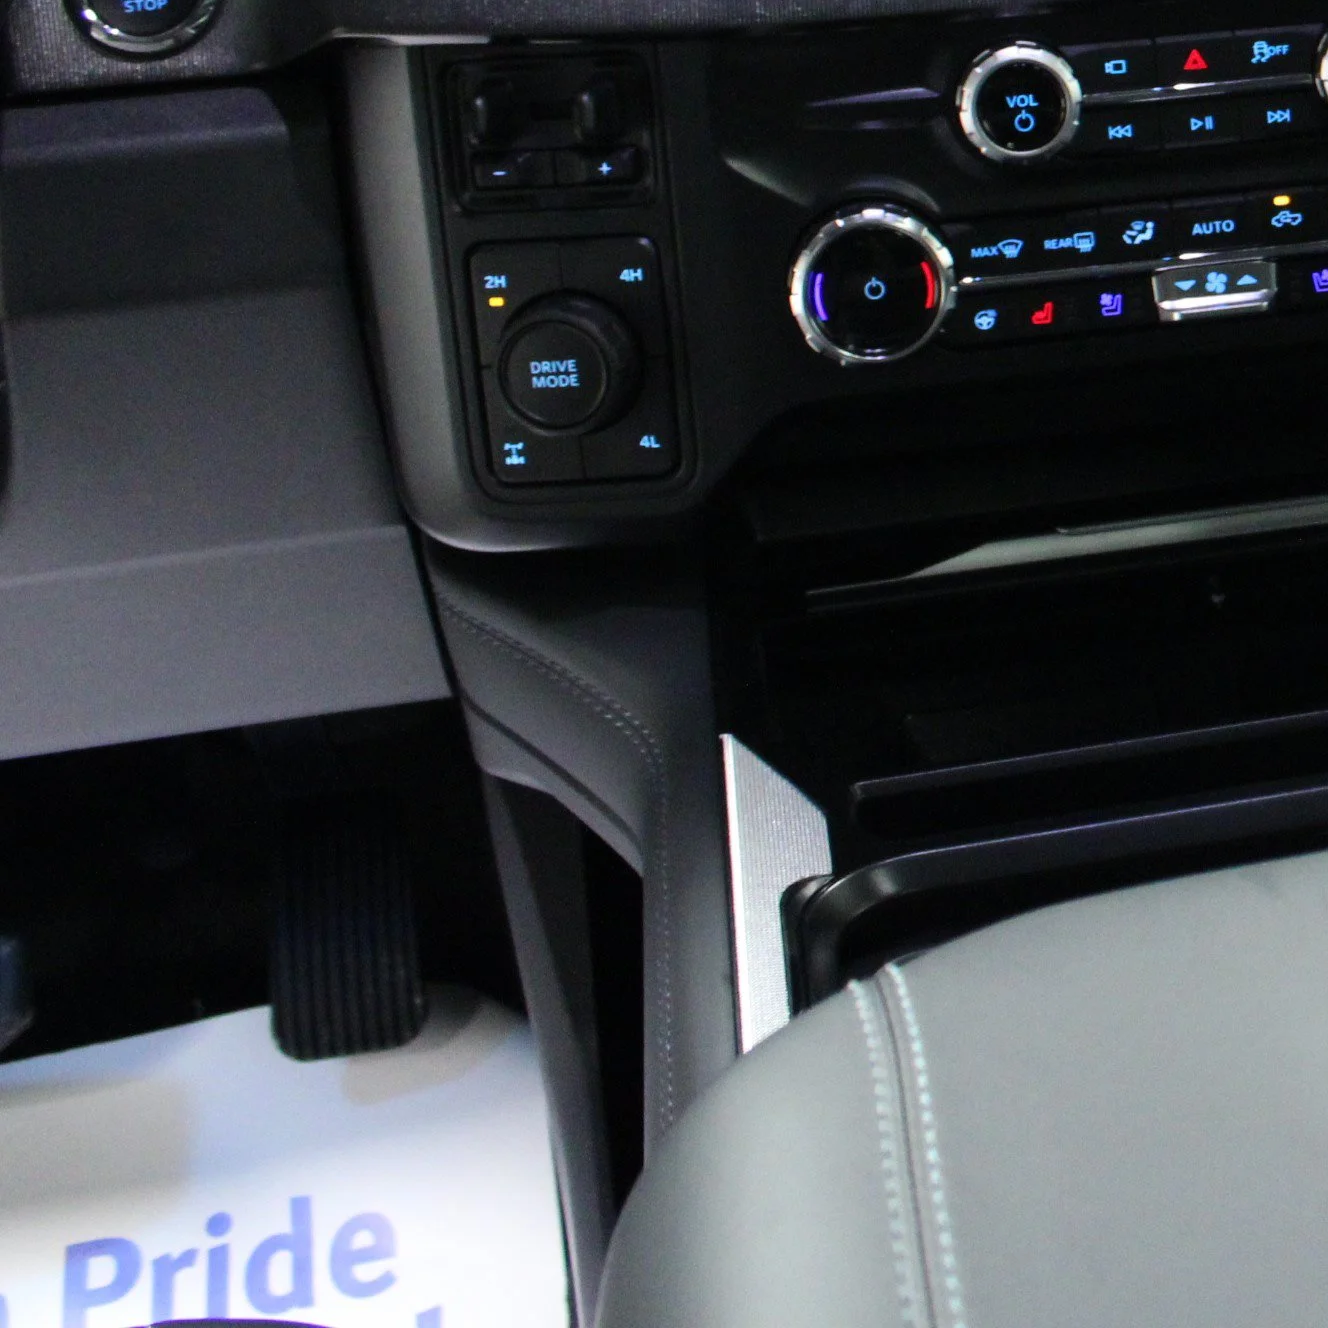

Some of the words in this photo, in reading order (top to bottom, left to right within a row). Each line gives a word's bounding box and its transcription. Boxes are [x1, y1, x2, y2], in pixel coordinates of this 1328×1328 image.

[1268, 42, 1290, 56] OFF
[1006, 95, 1039, 109] VOL
[1192, 219, 1235, 236] AUTO
[1044, 238, 1073, 251] REAR
[971, 246, 999, 259] MAX
[484, 274, 507, 290] 2H
[620, 267, 643, 282] 4H
[530, 359, 577, 375] DRIVE
[532, 373, 580, 389] MODE
[639, 435, 661, 449] 4L
[62, 1195, 398, 1328] Pride
